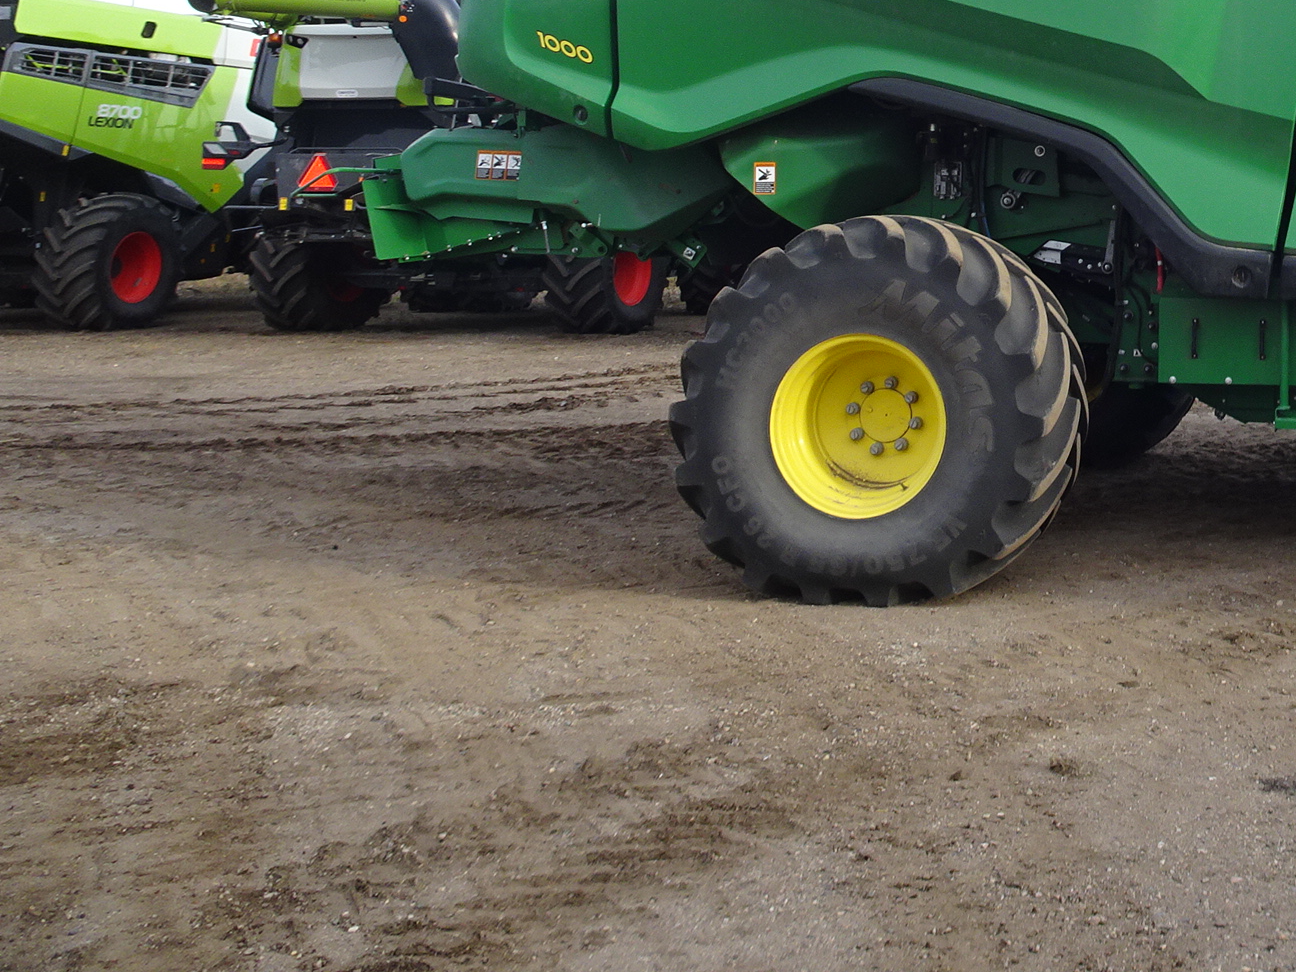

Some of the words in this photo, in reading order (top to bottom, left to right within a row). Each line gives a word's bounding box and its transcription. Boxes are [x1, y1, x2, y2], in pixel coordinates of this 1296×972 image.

[536, 30, 593, 62] 1000
[97, 104, 142, 119] 8700
[88, 116, 134, 129] LEXION
